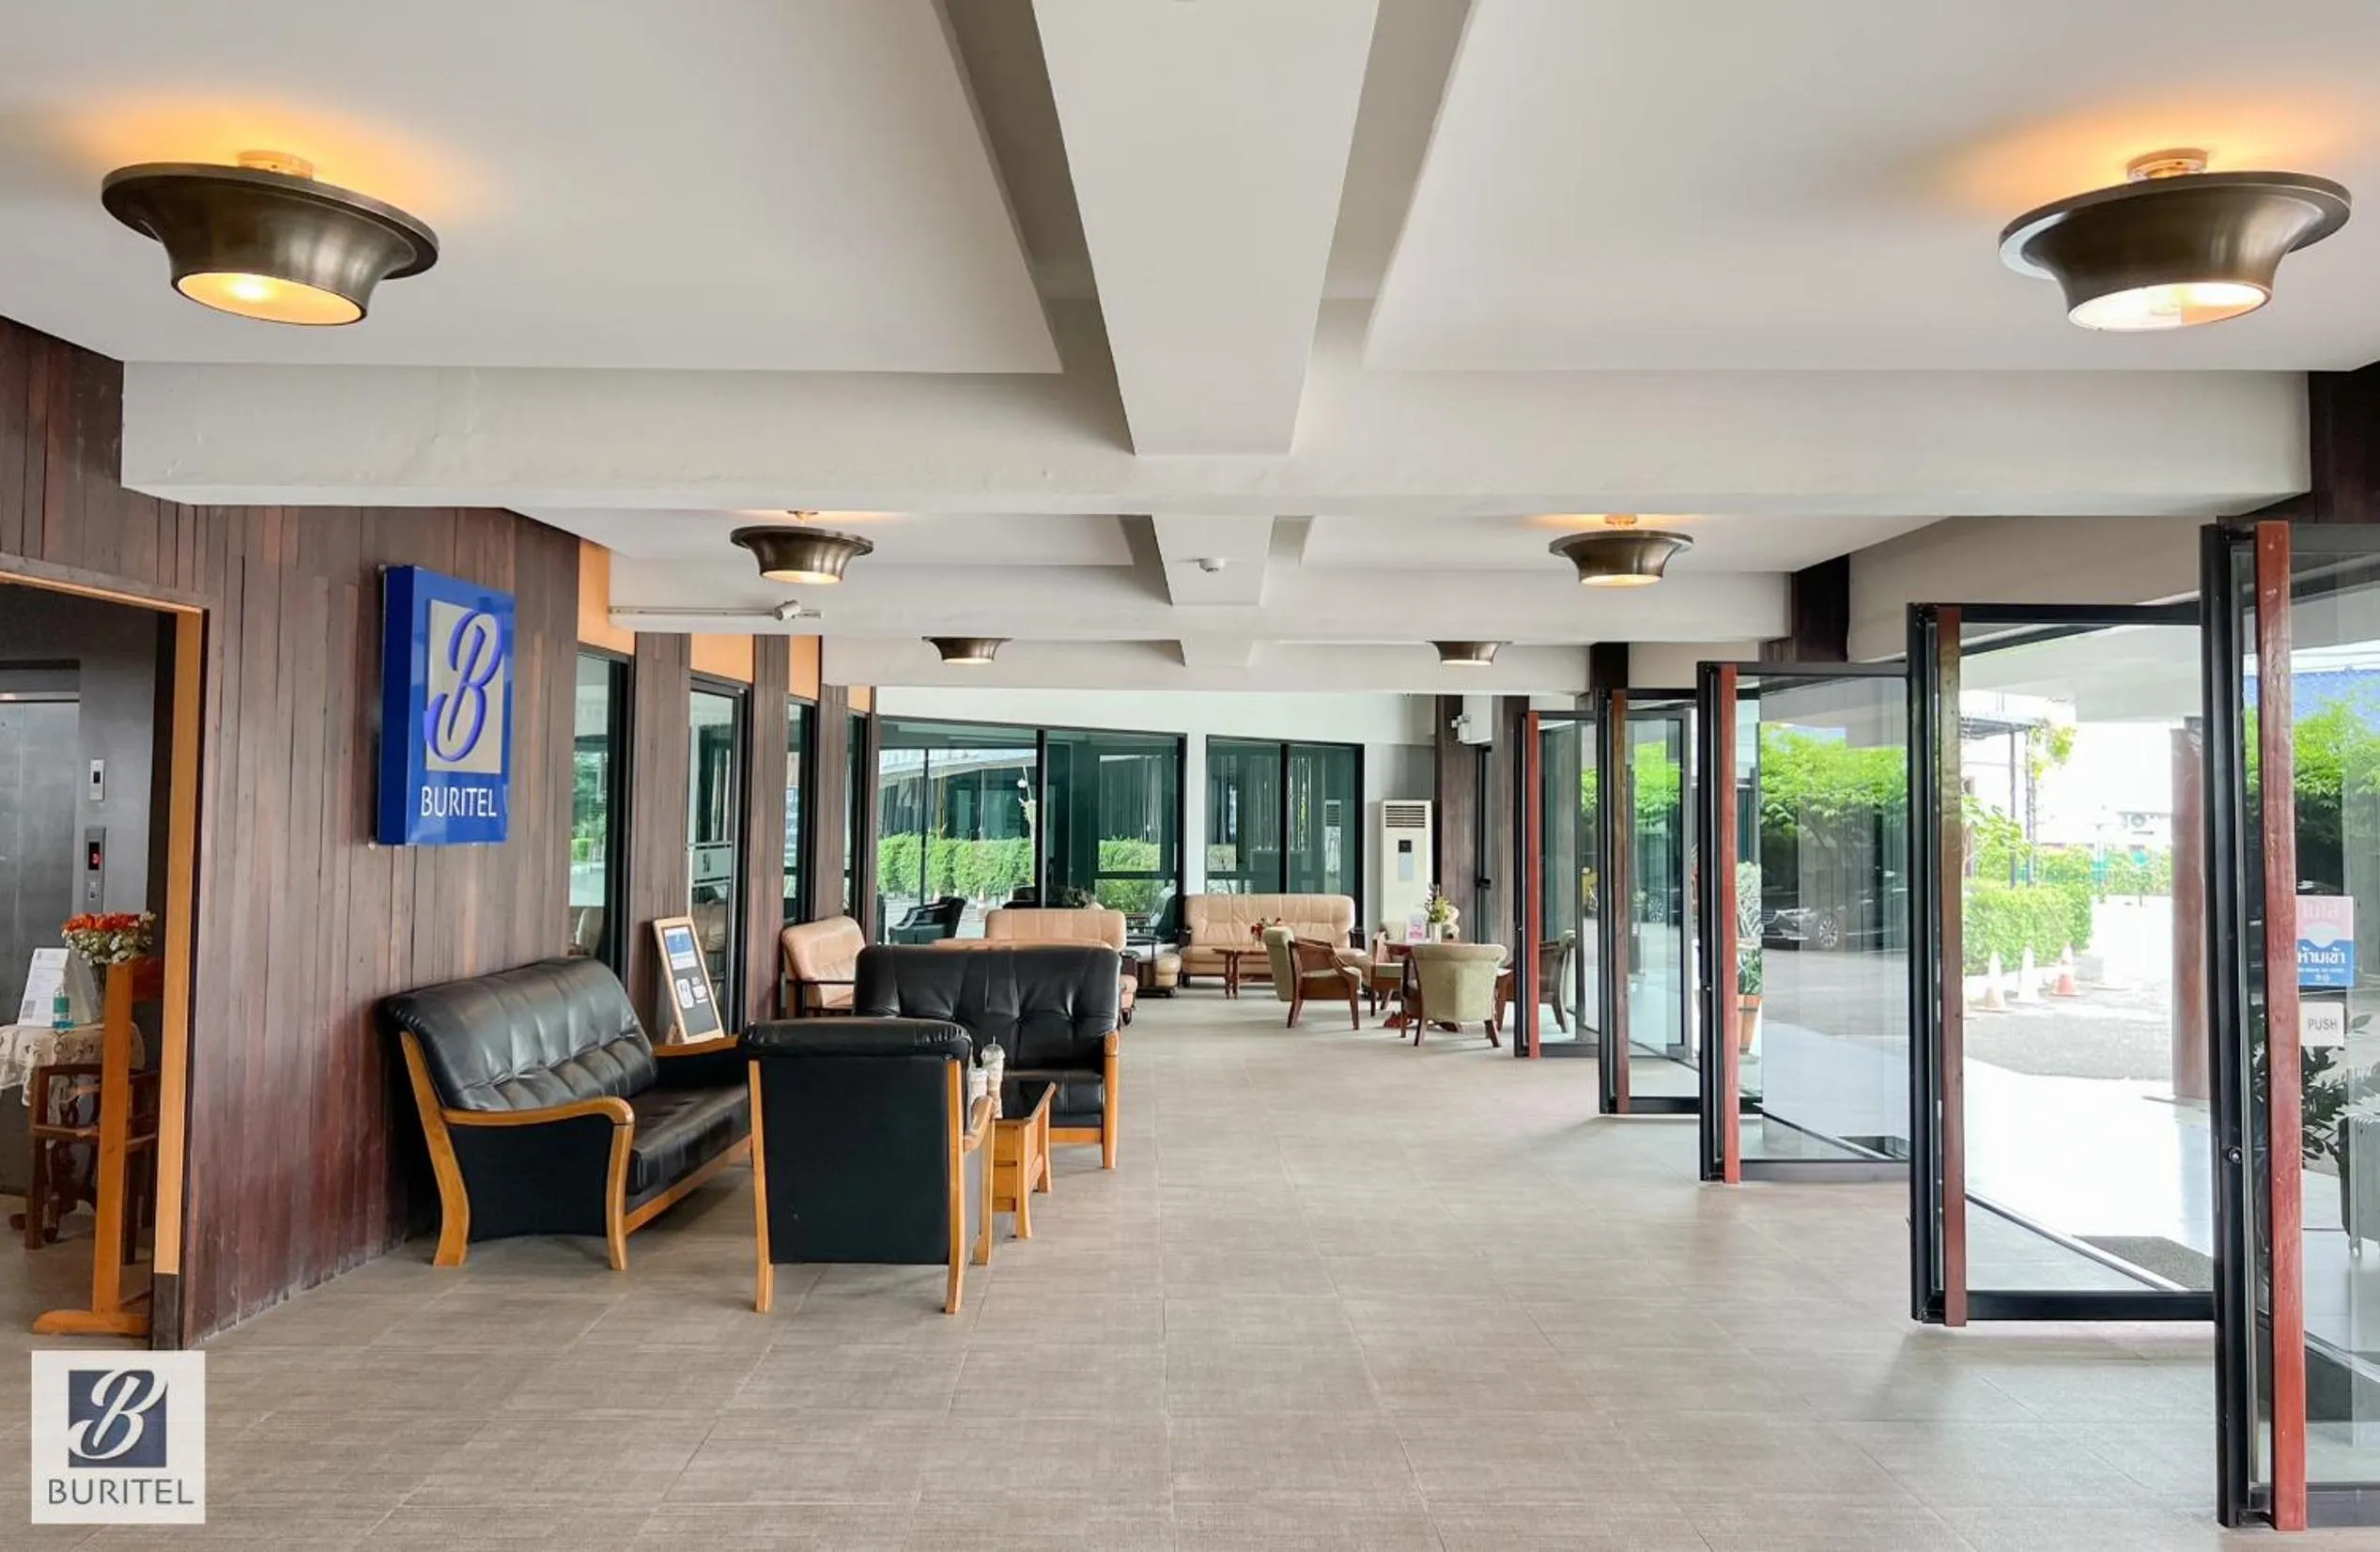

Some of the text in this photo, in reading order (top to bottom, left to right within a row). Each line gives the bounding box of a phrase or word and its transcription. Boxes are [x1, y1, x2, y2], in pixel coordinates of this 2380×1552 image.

[424, 610, 504, 762] B
[421, 785, 497, 817] BURITEL
[2308, 1017, 2338, 1031] PUSH
